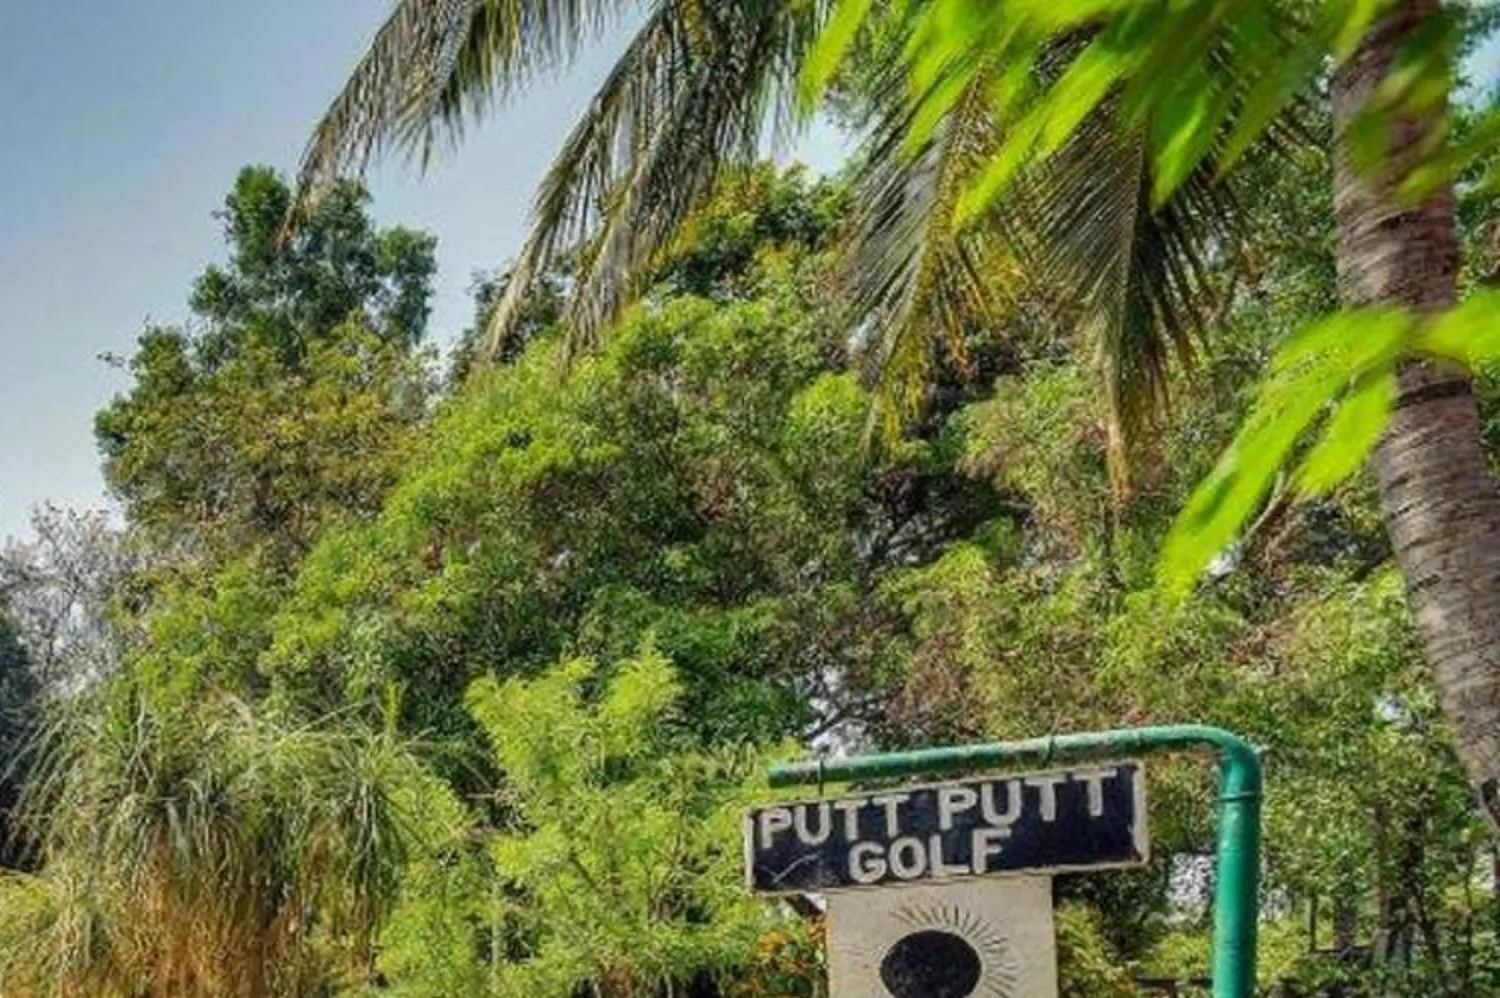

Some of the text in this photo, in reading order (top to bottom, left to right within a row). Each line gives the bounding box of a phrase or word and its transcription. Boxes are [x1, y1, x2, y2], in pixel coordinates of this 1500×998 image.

[760, 769, 1117, 849] PUTT PUTT
[848, 827, 1012, 884] GOLF
